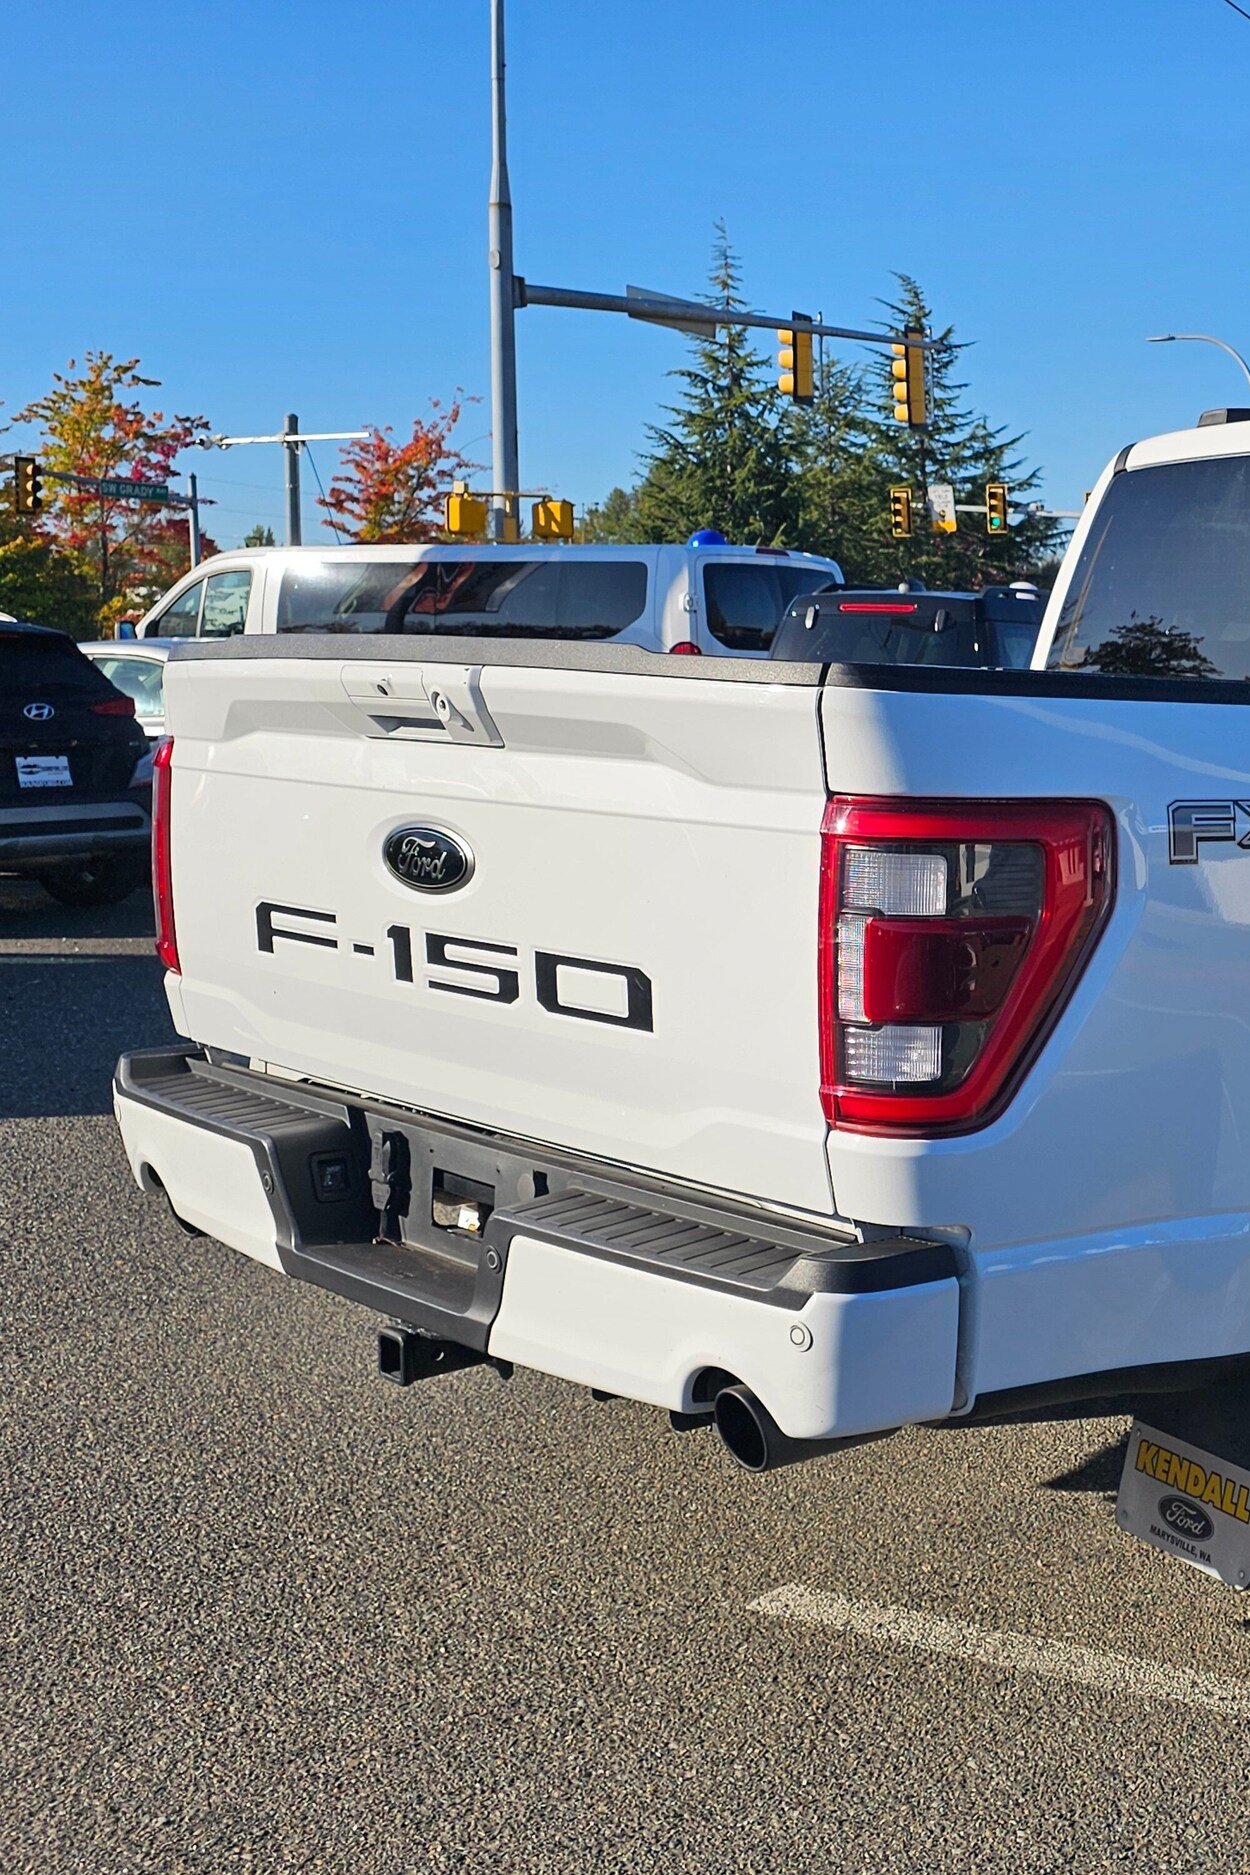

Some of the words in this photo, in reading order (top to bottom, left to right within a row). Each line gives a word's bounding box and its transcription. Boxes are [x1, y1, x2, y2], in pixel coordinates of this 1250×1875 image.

[102, 481, 117, 493] SW
[119, 484, 154, 498] GRADY
[397, 836, 448, 879] Ford
[255, 900, 655, 1034] F-150
[1135, 1439, 1250, 1524] KENDALL
[1165, 1501, 1205, 1536] Ford
[1150, 1524, 1198, 1558] MARYSVILLE,
[1199, 1551, 1212, 1564] WA
